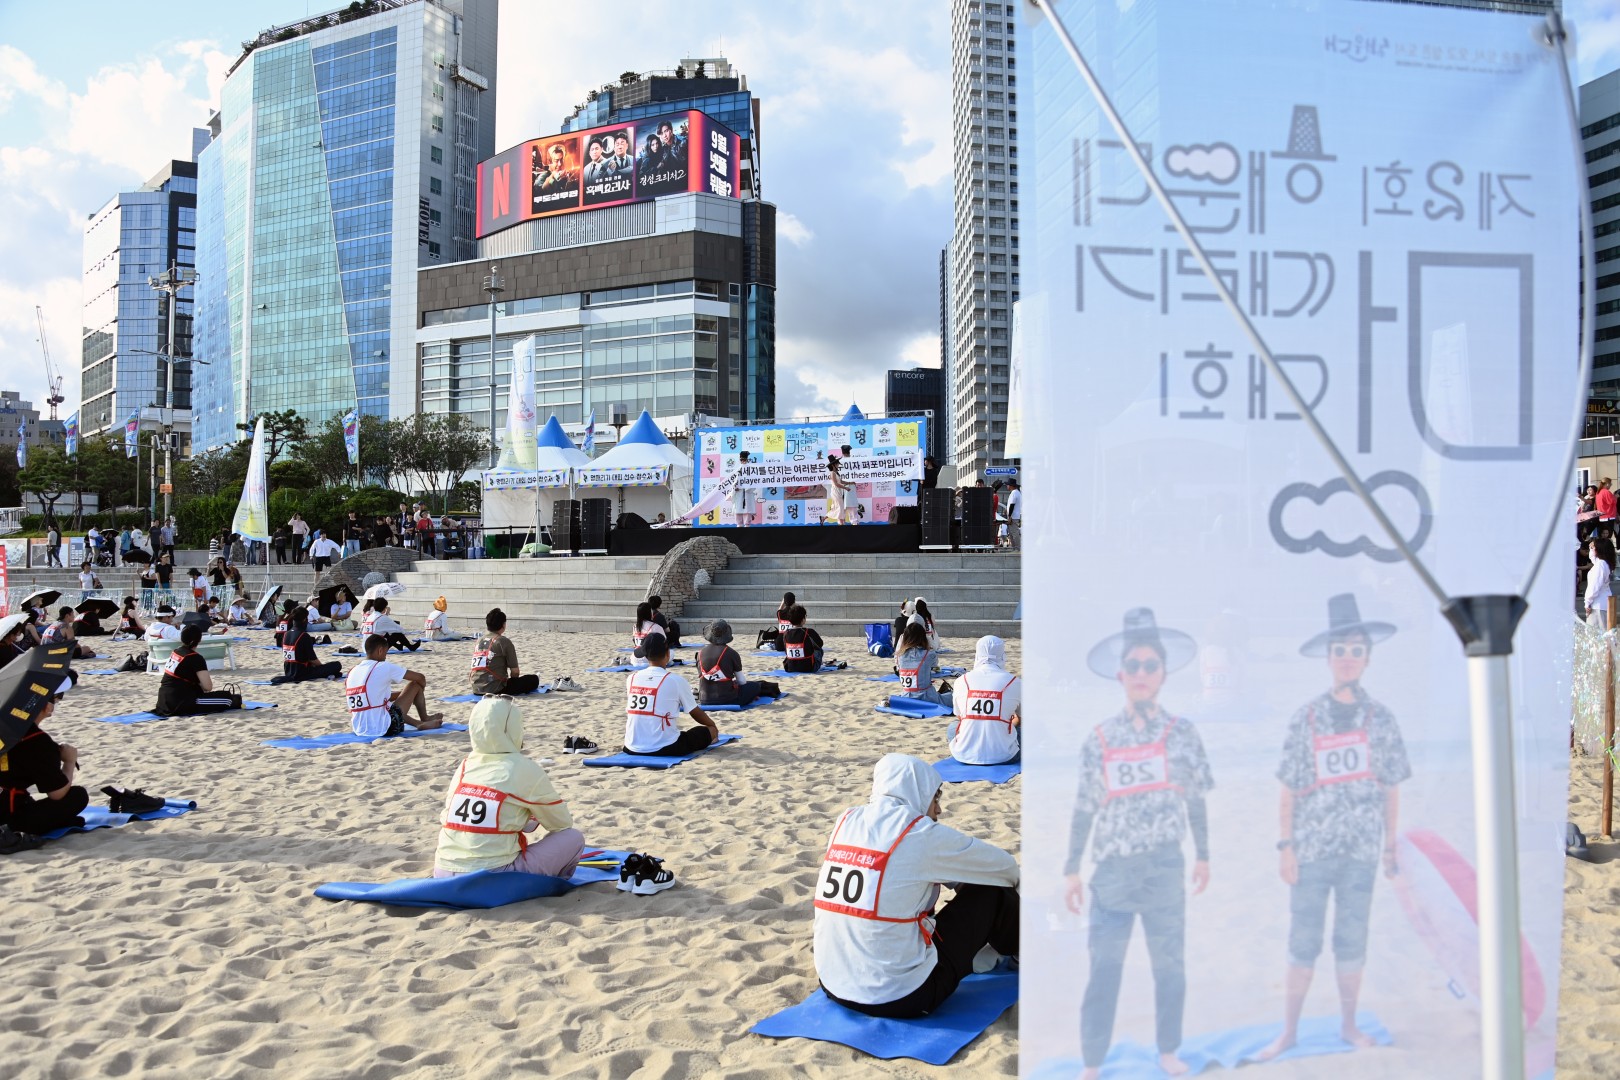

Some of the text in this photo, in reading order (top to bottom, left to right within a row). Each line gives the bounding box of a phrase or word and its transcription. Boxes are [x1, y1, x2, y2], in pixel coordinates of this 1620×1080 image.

[710, 150, 727, 177] 넷플
[493, 162, 511, 220] N
[585, 179, 631, 195] 흑백요리사
[710, 173, 732, 197] 뭐봄?
[419, 198, 430, 246] HOTEL
[767, 465, 792, 476] 던지는
[793, 462, 826, 475] 여러분은
[861, 457, 915, 470] 퍼포머입니다.
[739, 477, 761, 486] player
[761, 475, 775, 484] and
[782, 474, 817, 484] performer
[870, 469, 907, 479] messages.
[472, 657, 483, 667] 27
[790, 649, 801, 658] 18
[348, 695, 363, 708] 38
[630, 694, 648, 710] 39
[971, 699, 994, 715] 40
[454, 798, 487, 825] 49
[828, 848, 876, 866] 멍때리기 대회
[822, 865, 864, 904] 50
